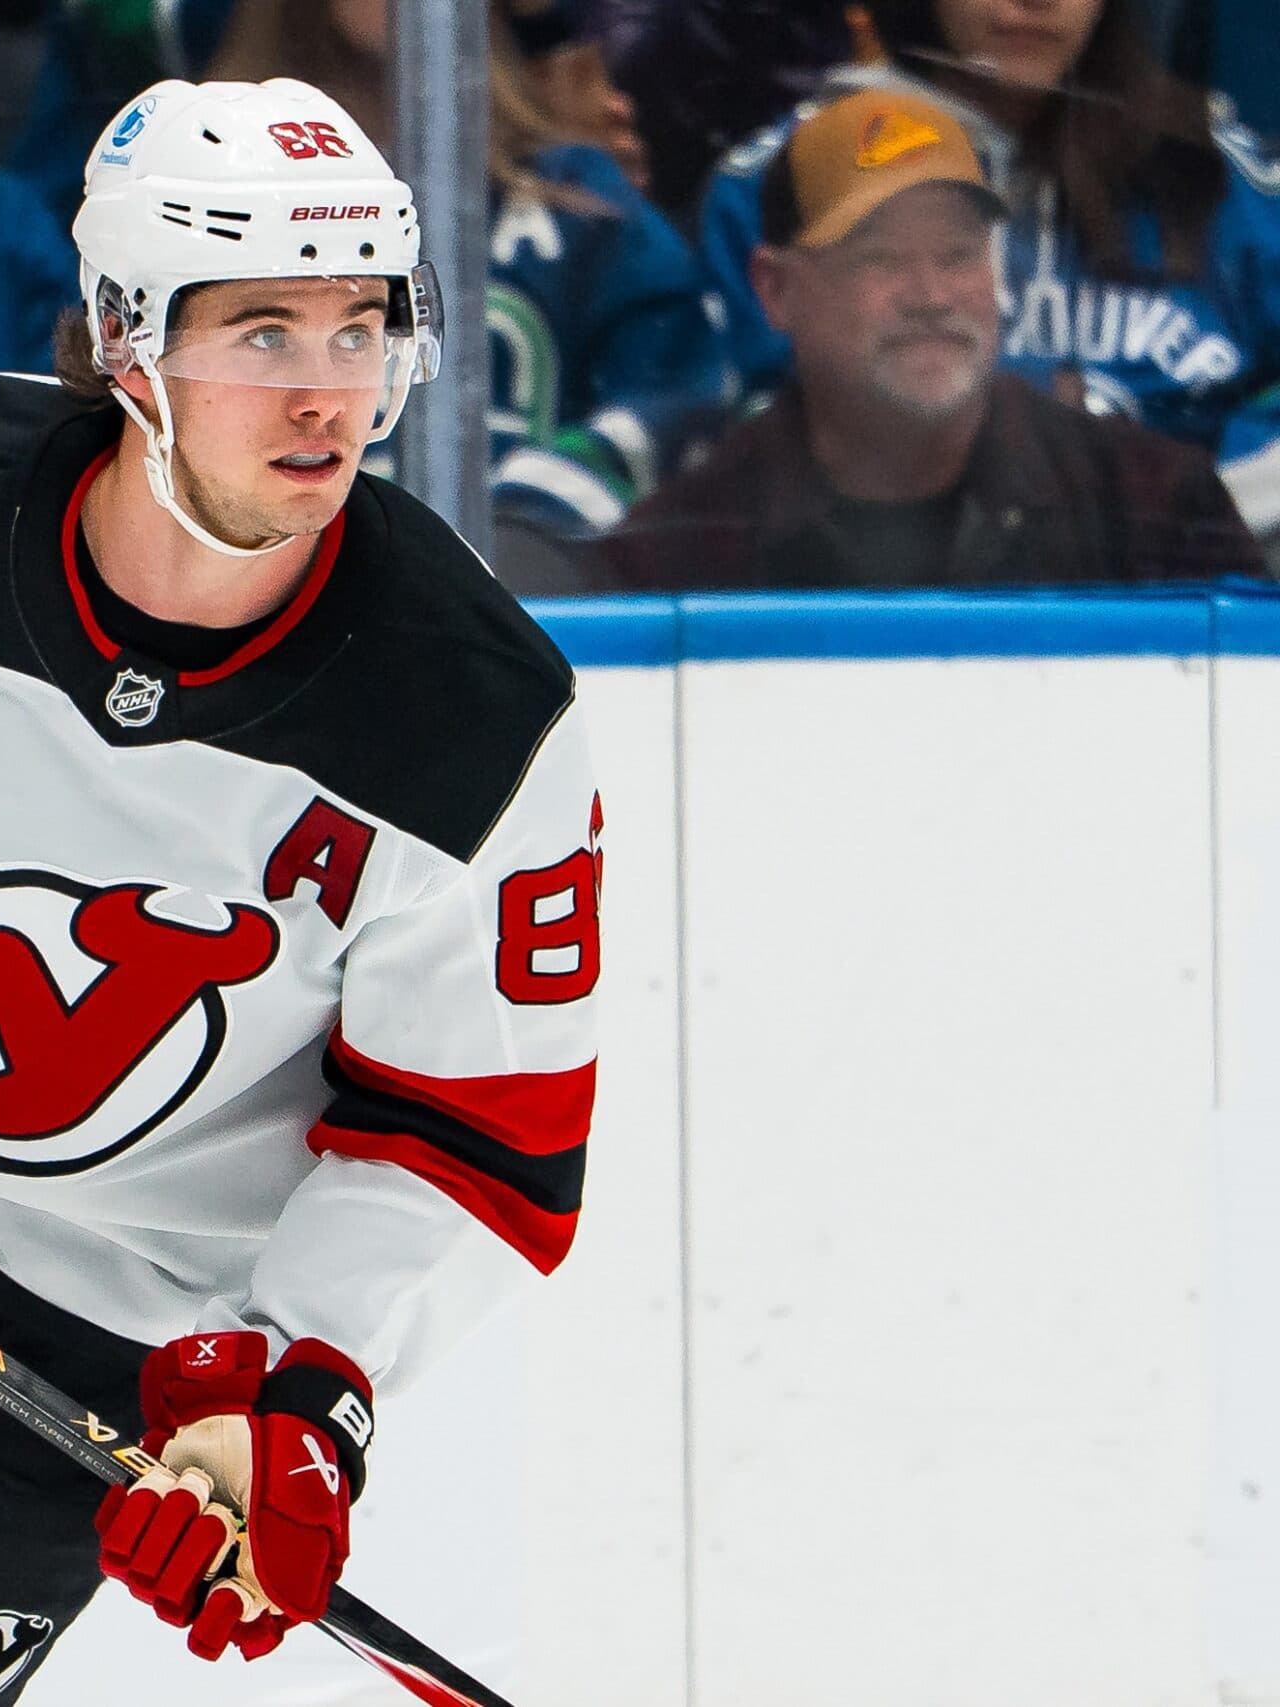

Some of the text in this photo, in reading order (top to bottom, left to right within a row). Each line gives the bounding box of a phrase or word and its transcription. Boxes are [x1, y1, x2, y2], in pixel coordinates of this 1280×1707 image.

[267, 121, 354, 160] 86
[290, 206, 380, 221] BAUER
[116, 692, 151, 711] NHL
[263, 795, 378, 931] A
[495, 790, 603, 1005] 8
[33, 1417, 74, 1449] TAPER
